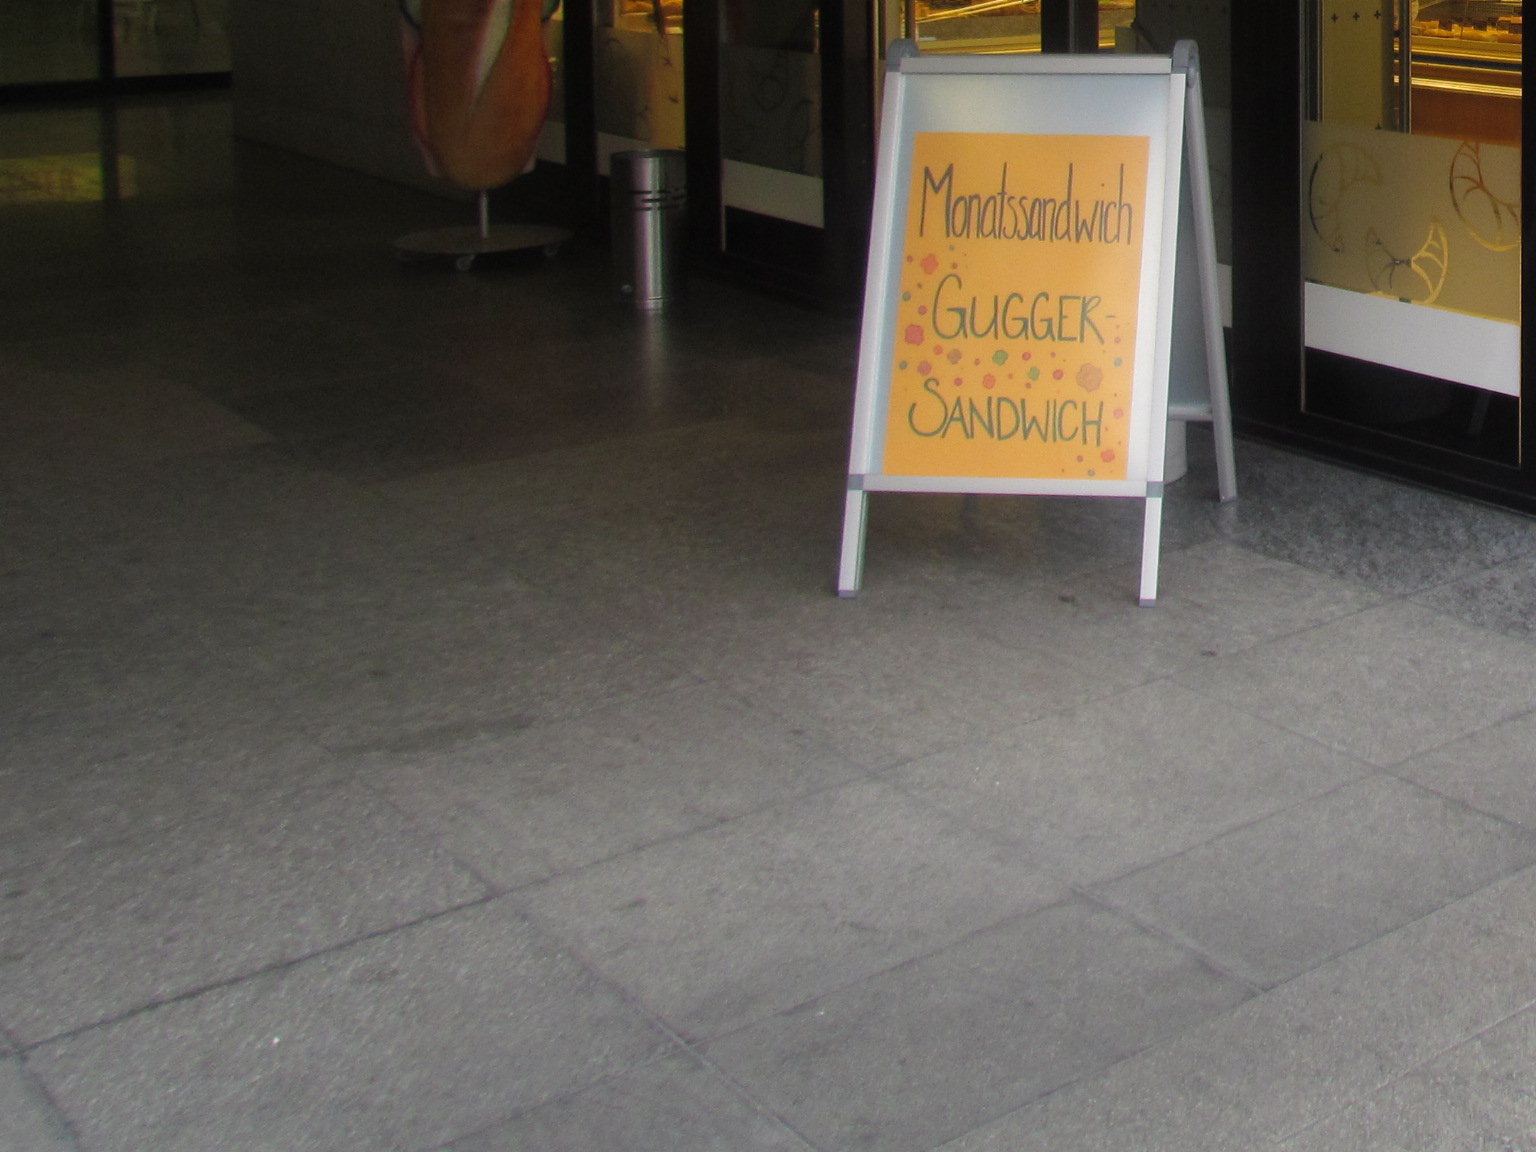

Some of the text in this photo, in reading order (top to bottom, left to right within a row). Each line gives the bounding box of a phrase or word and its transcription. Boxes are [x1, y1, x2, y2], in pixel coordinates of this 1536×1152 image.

[919, 161, 1133, 245] Monatssandwich
[931, 273, 1117, 344] GUGGER-
[907, 378, 1104, 447] SANDWICH
